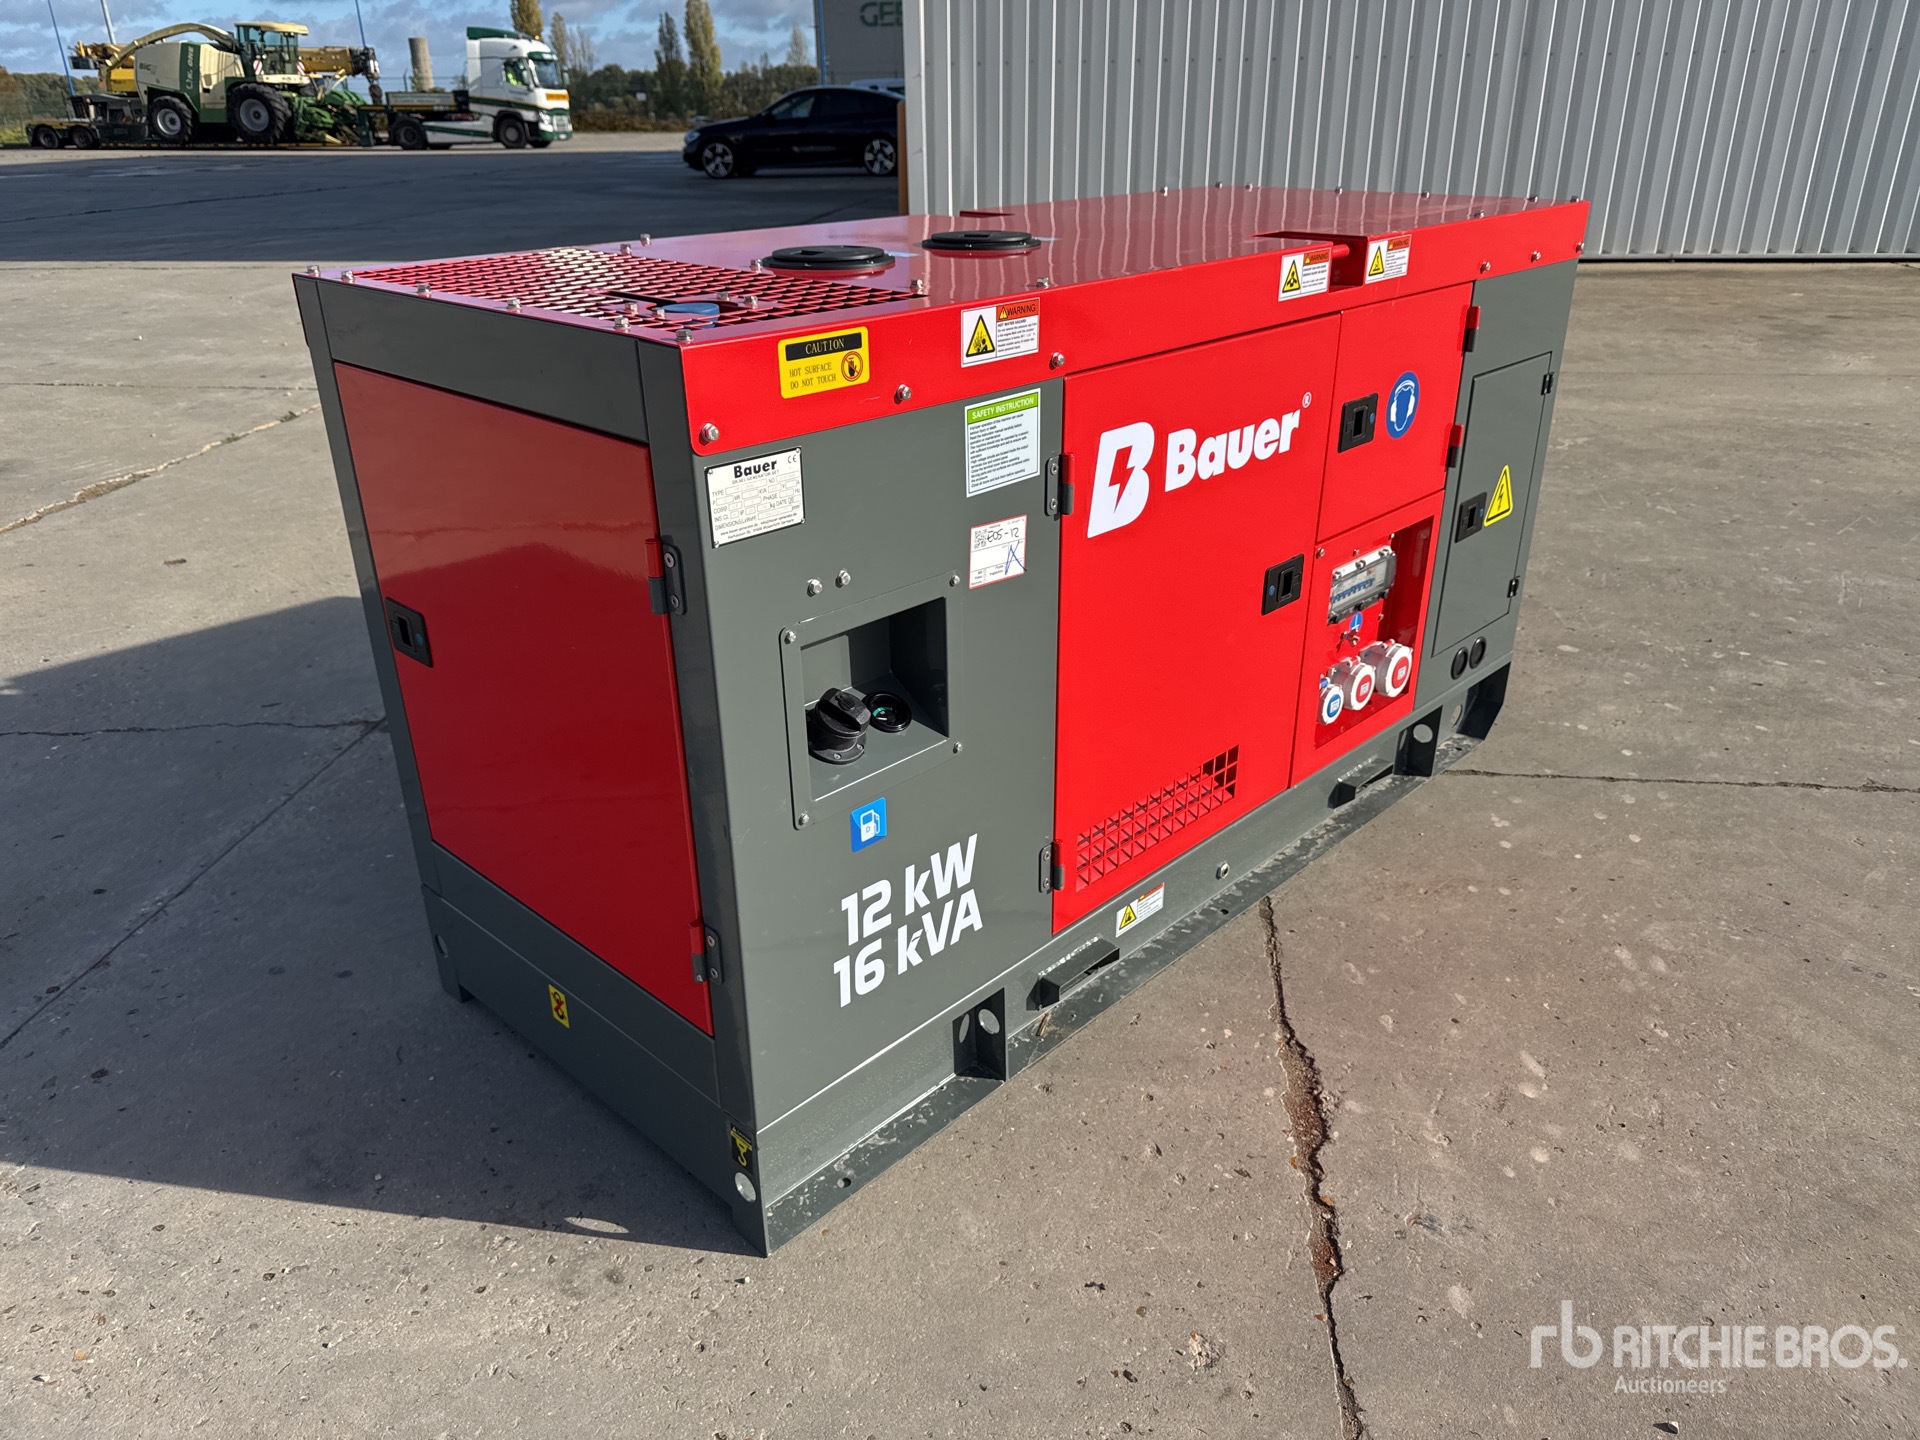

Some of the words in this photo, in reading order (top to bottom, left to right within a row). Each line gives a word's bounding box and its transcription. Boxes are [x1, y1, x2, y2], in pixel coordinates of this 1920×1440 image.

[1007, 303, 1036, 316] WARNING
[805, 338, 845, 355] CAUTION
[789, 367, 802, 378] HOT
[804, 362, 832, 375] SURFACE
[790, 381, 799, 390] DO
[801, 377, 814, 388] NOT
[816, 372, 837, 384] TOUCH
[971, 406, 995, 420] SAFETY
[995, 396, 1035, 414] INSTRUCTION
[1164, 409, 1301, 493] Bauer
[734, 460, 777, 479] Bauer
[841, 879, 892, 946] 12
[904, 833, 978, 916] kW
[833, 938, 885, 1008] 16
[897, 888, 983, 975] kVA
